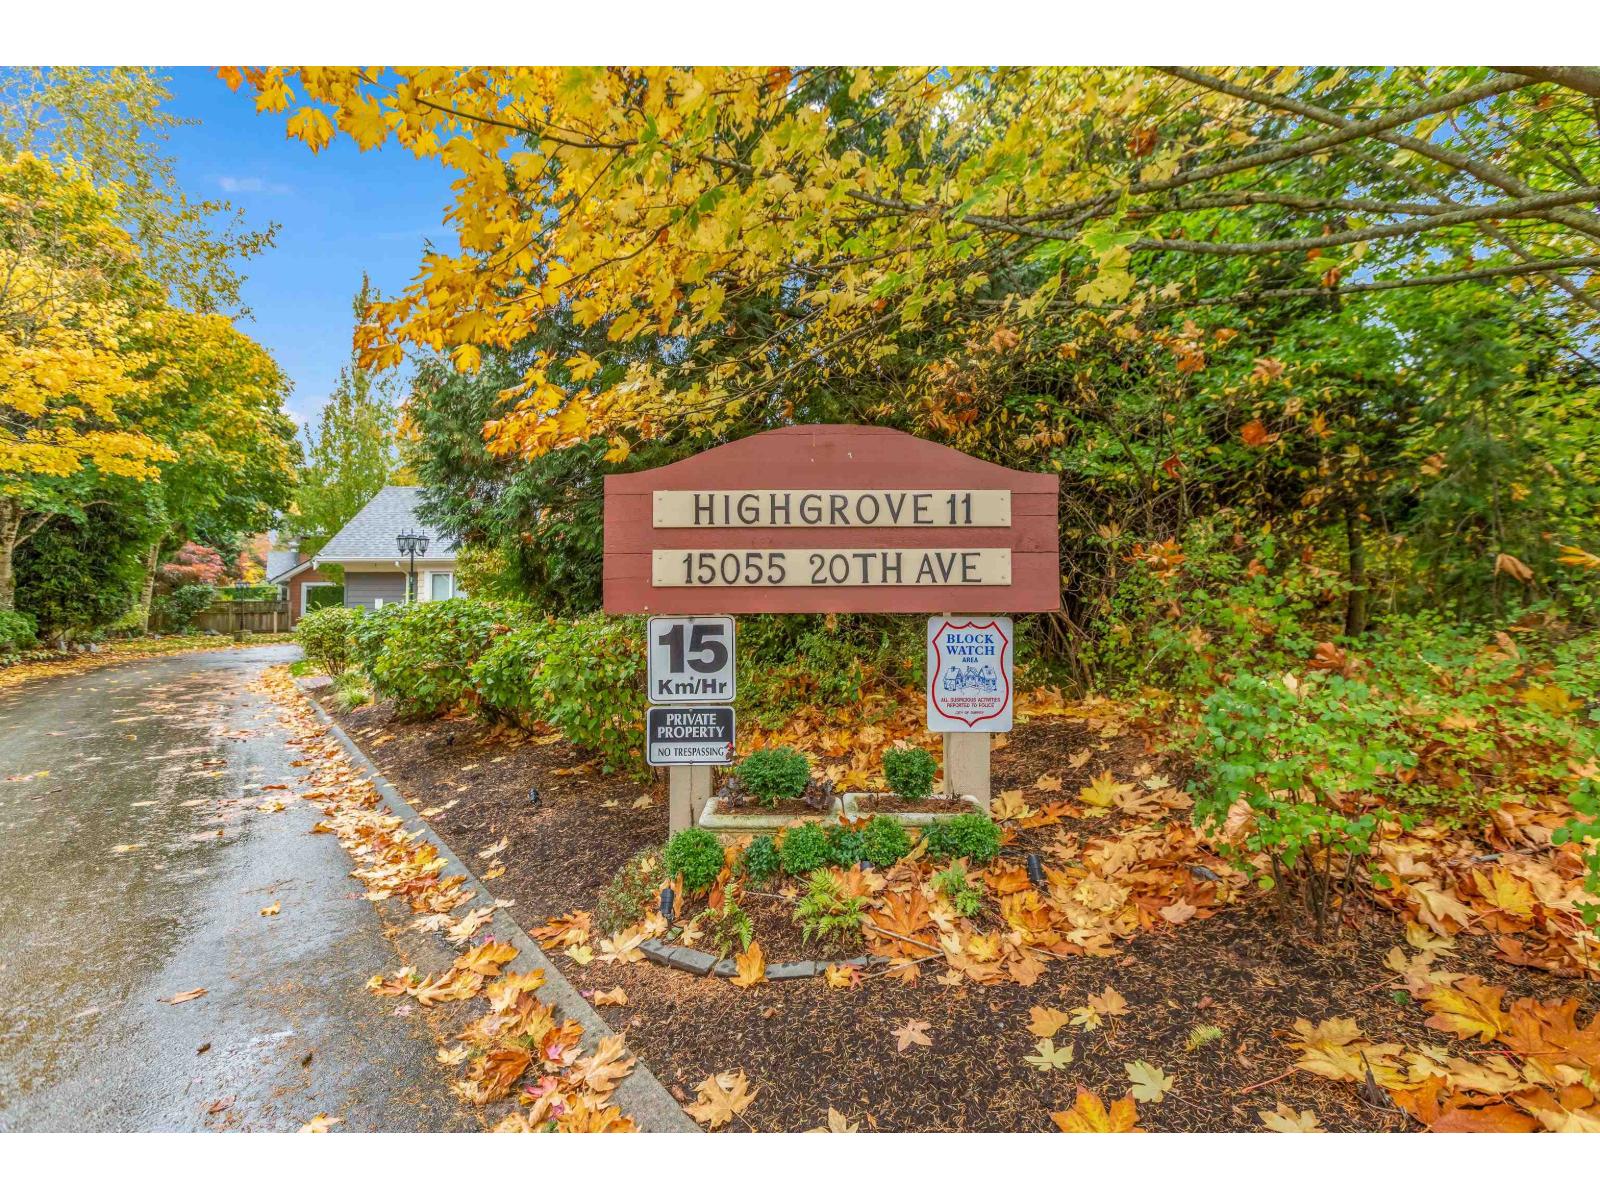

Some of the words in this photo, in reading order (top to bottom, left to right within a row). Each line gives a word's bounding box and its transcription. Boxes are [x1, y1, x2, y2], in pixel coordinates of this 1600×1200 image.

[694, 493, 934, 525] HIGHGROVE
[946, 493, 973, 525] 11
[683, 552, 787, 585] 15055
[809, 553, 902, 585] 20TH
[916, 552, 982, 584] AVE
[946, 634, 994, 643] BLOCK
[658, 624, 728, 674] 15
[946, 646, 994, 655] WATCH
[658, 678, 727, 695] Km/Hr
[666, 713, 717, 726] PRIVATE
[657, 726, 725, 739] PROPERTY
[658, 747, 671, 757] NO
[674, 746, 724, 757] TRESPASSING
